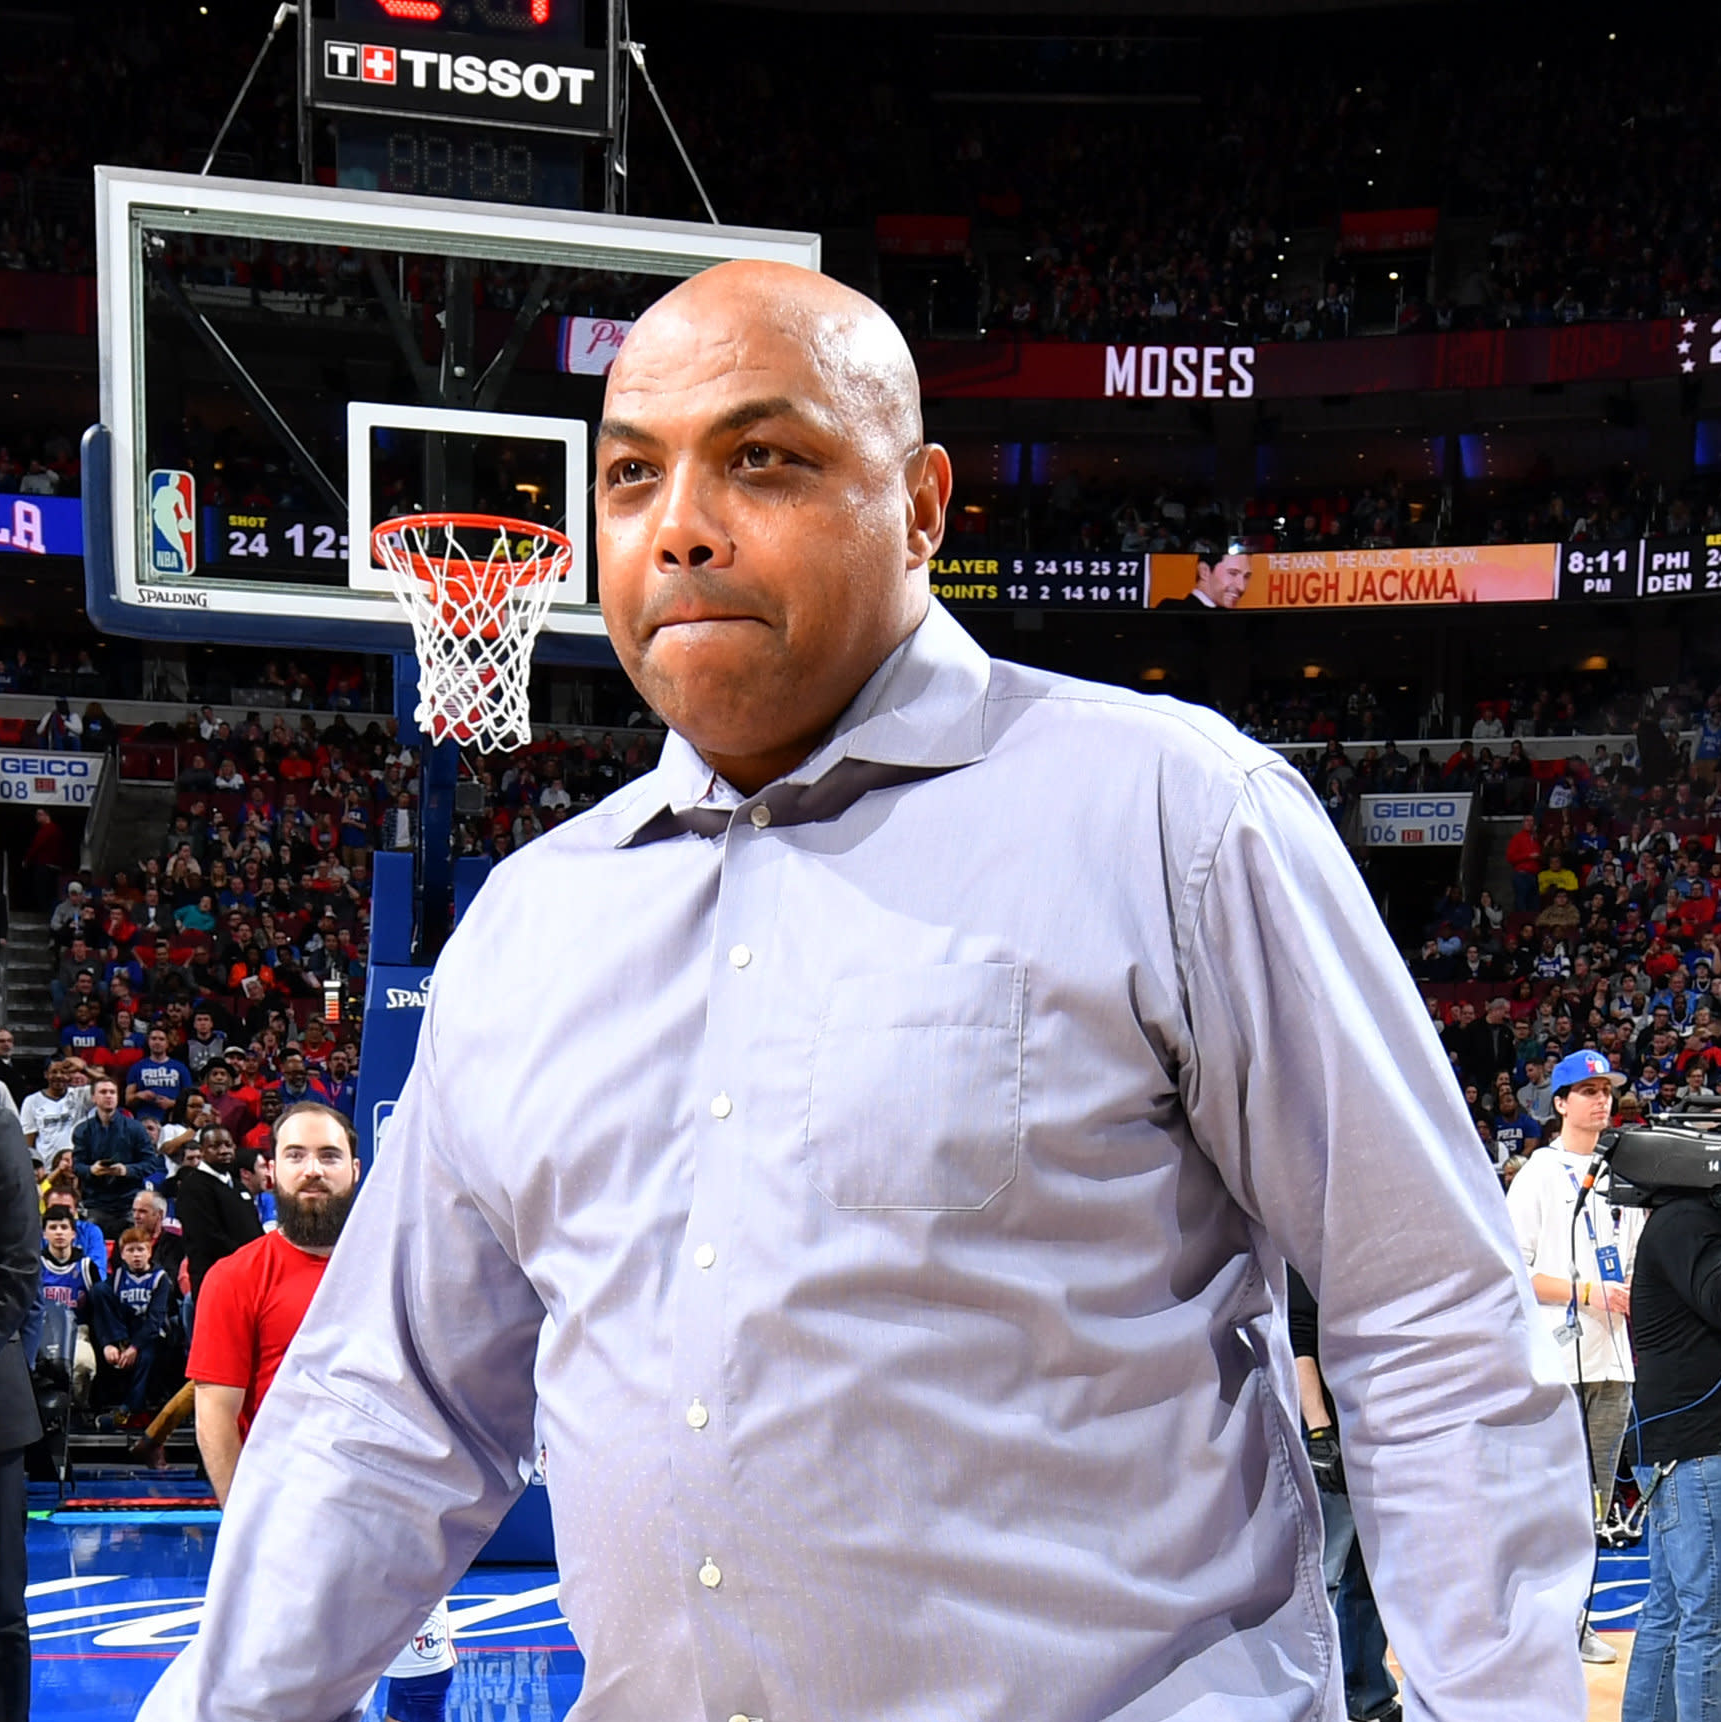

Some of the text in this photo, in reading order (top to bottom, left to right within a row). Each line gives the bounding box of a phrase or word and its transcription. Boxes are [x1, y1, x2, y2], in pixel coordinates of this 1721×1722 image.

[400, 49, 595, 105] TISSOT
[1103, 345, 1256, 399] MOSES
[229, 515, 268, 528] SHOT
[229, 531, 269, 558] 24
[156, 550, 179, 569] NBA
[928, 559, 1139, 576] PLAYER 5 24 15 25 27
[1267, 554, 1292, 571] THE
[1292, 554, 1326, 570] MAN.
[1335, 551, 1357, 568] THE
[1410, 549, 1432, 566] THE
[1434, 548, 1478, 566] SHOW.
[1568, 550, 1627, 574] 8:11
[1652, 551, 1690, 571] PHI
[930, 585, 1138, 601] POINTS 12 2 14 10 11
[1267, 567, 1476, 605] HUGH JACKMA
[1583, 579, 1612, 593] PM
[1647, 574, 1692, 593] DEN
[138, 587, 208, 609] SPALDING
[1, 757, 89, 777] GEICO
[1373, 802, 1456, 818] GEICO
[1363, 824, 1396, 842] 106
[1429, 823, 1464, 842] 105
[1708, 1160, 1719, 1172] 14
